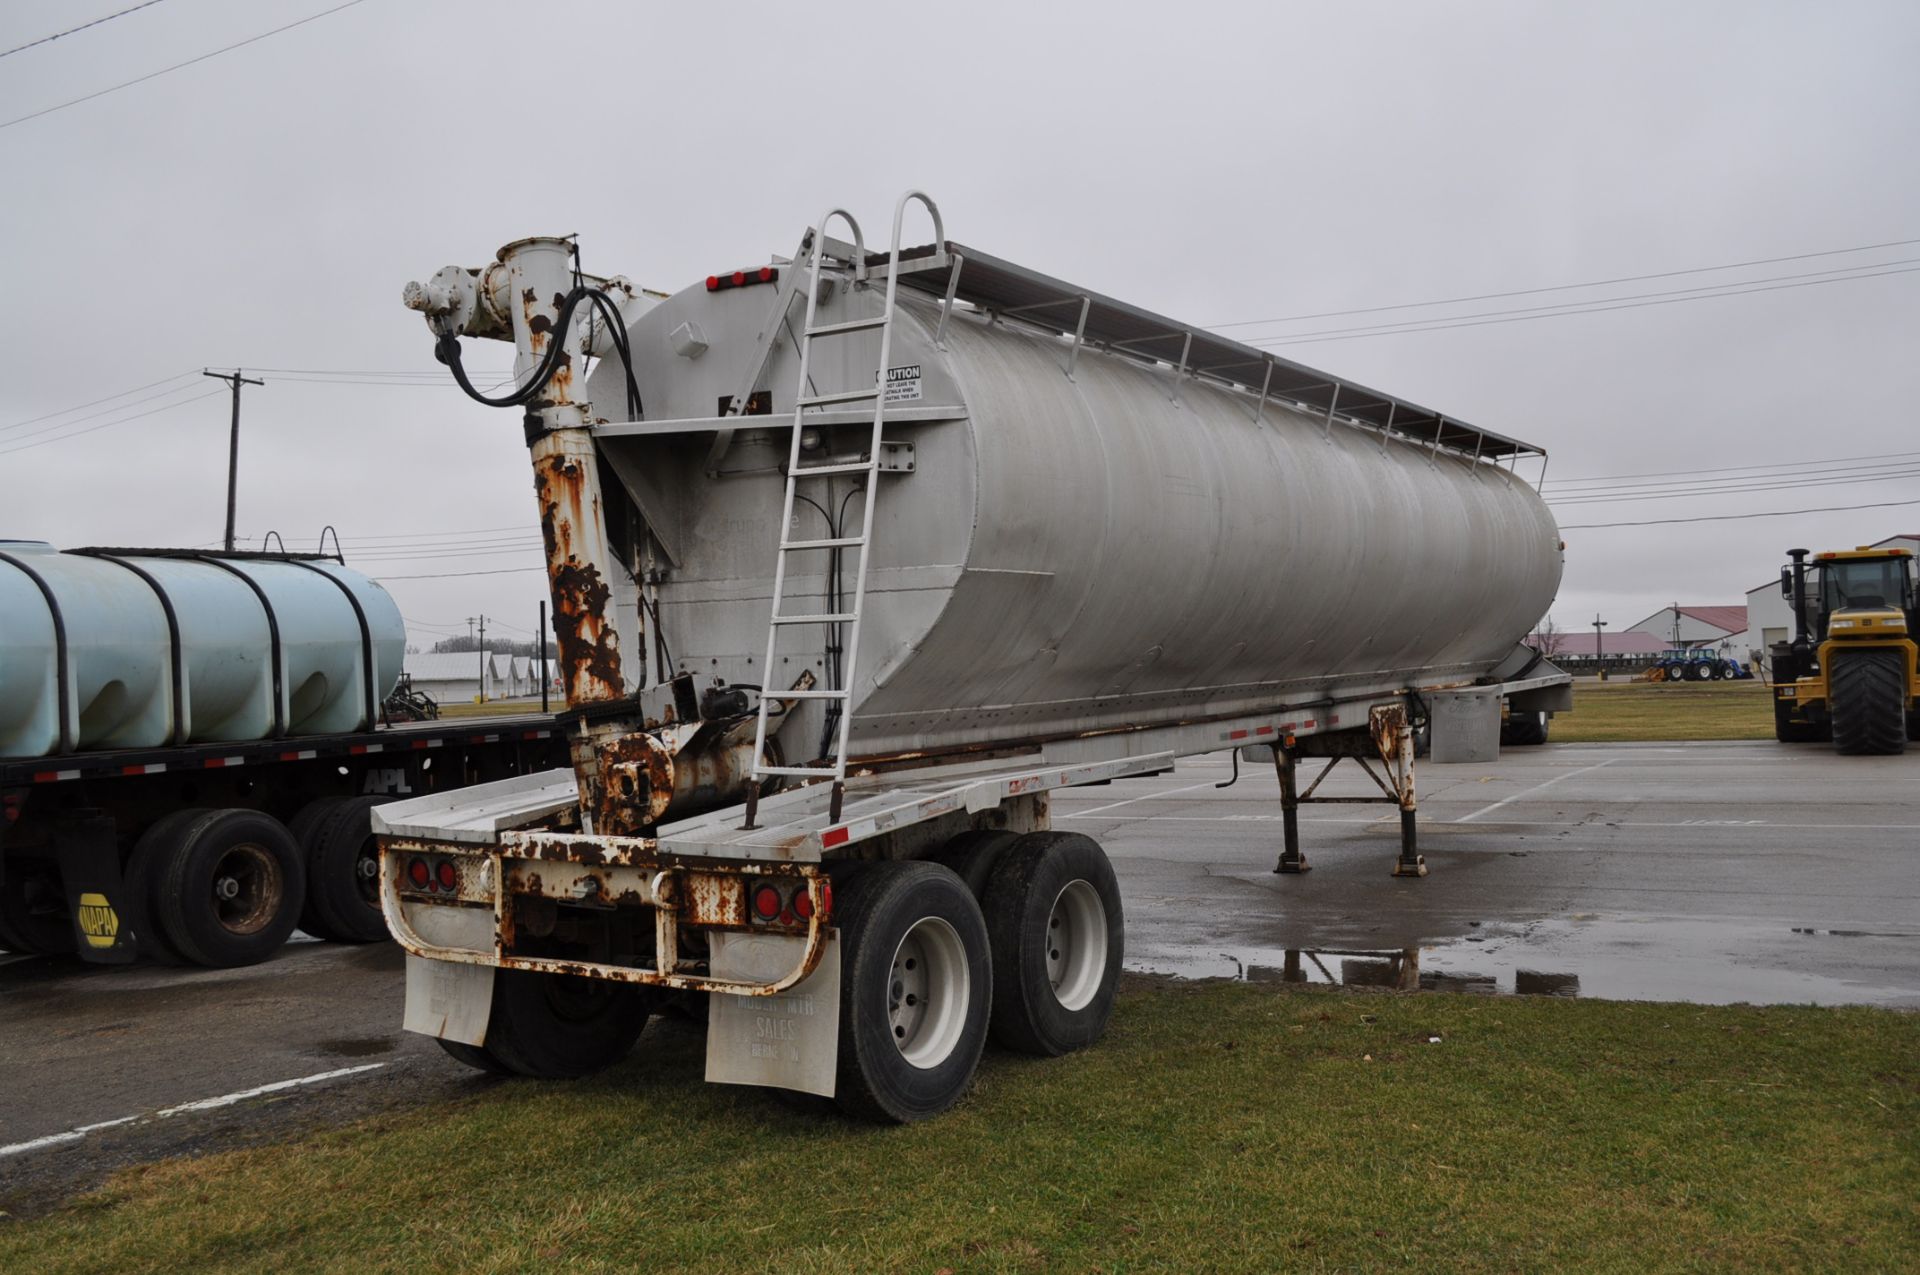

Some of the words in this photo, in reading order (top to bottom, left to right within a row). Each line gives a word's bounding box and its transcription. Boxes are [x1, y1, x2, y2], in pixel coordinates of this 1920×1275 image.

[877, 367, 920, 380] UTION
[363, 768, 412, 793] APL
[82, 906, 115, 936] NAPA
[756, 1016, 795, 1041] SALES
